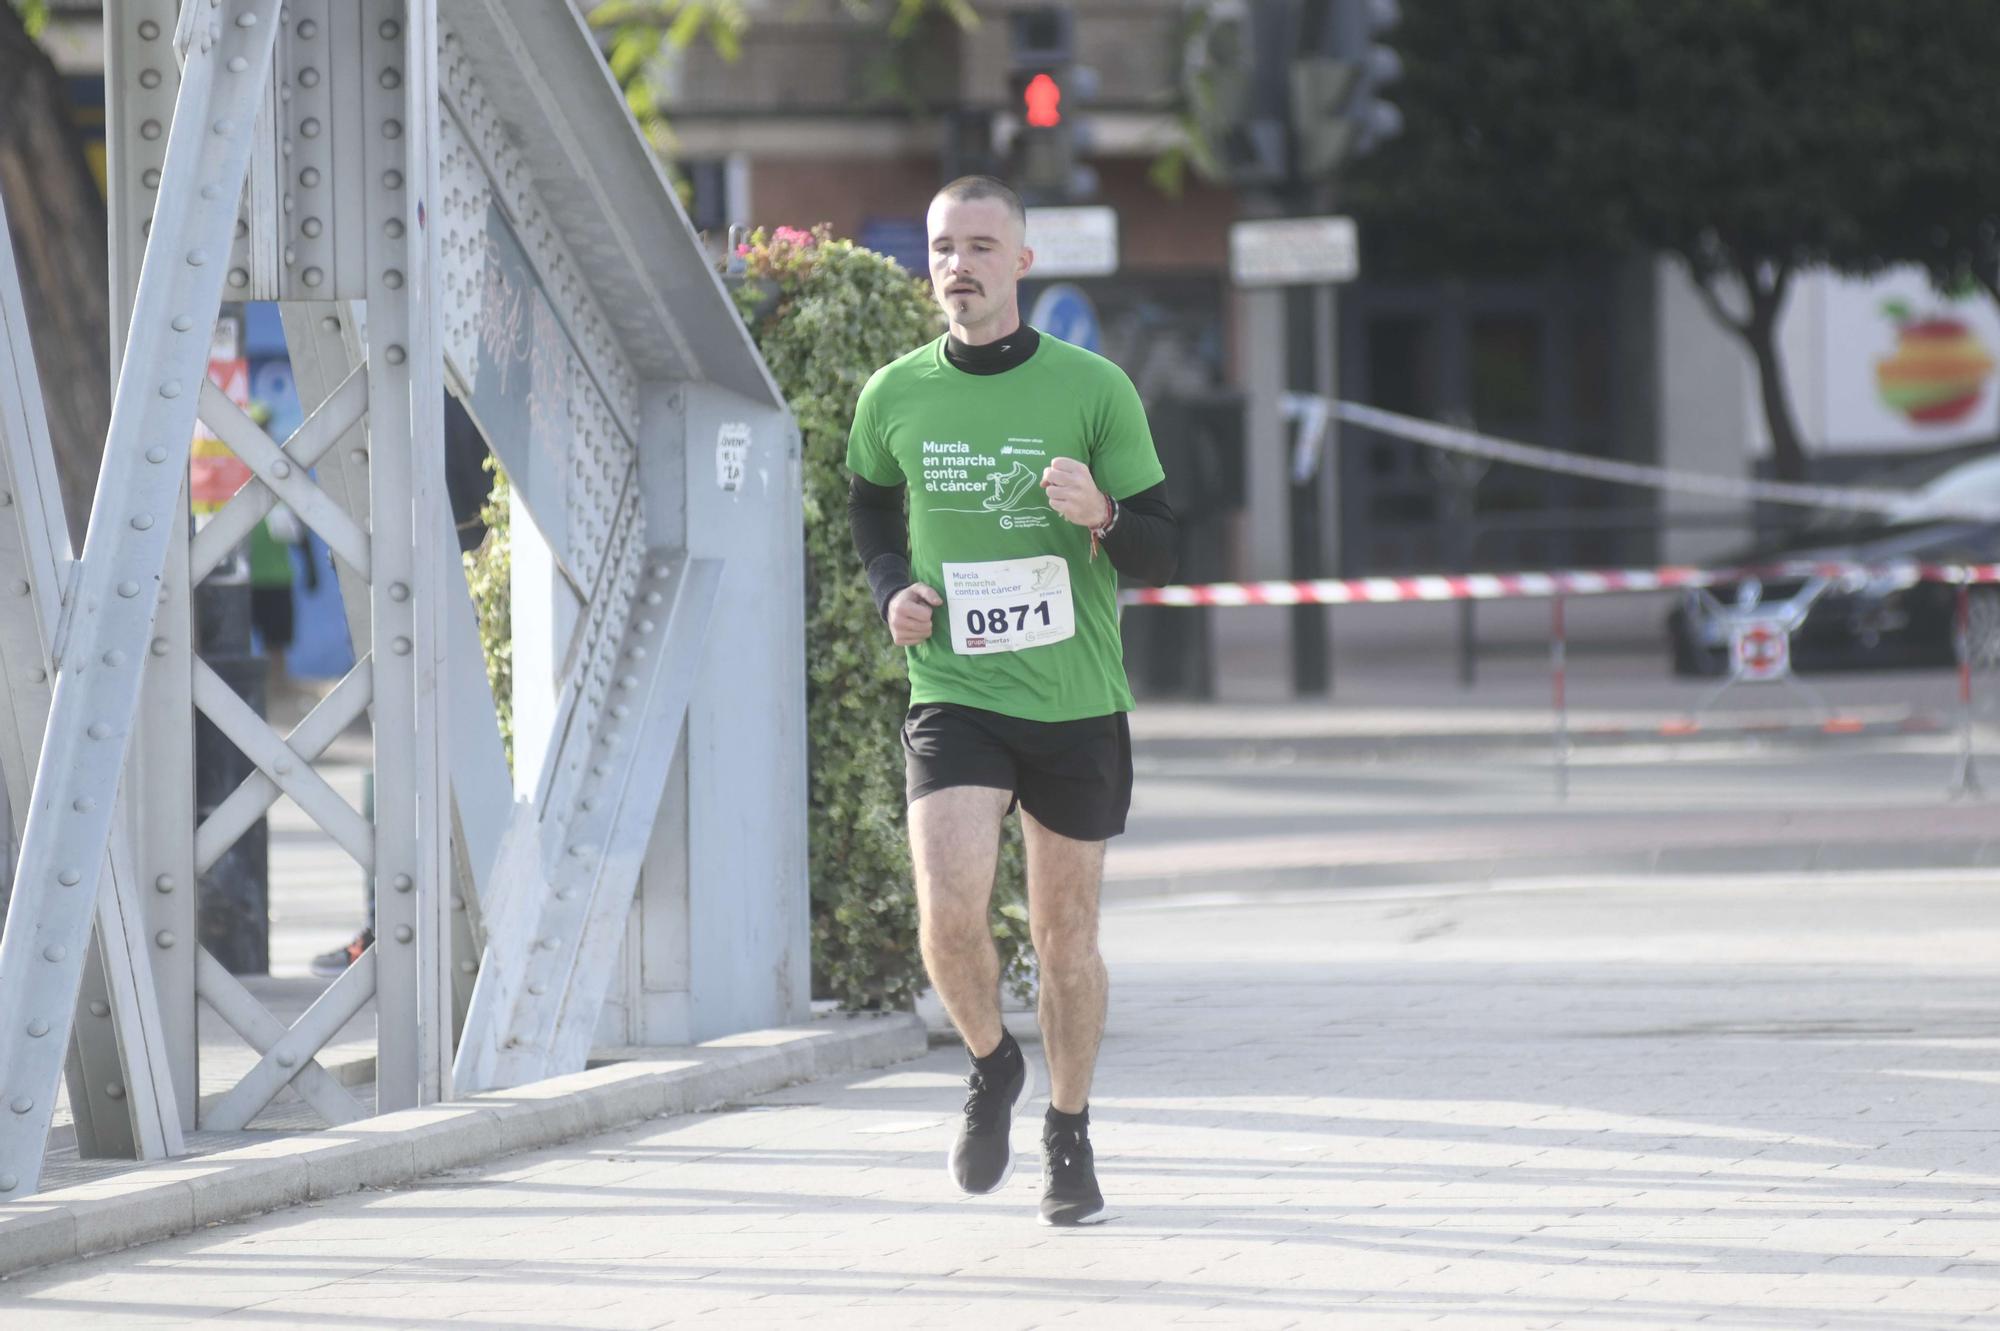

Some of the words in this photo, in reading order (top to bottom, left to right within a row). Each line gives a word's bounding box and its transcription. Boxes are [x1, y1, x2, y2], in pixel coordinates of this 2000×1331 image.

[922, 441, 969, 453] Murcia
[922, 457, 939, 466] en
[943, 454, 996, 466] marcha
[924, 468, 968, 480] contra
[925, 482, 938, 492] el
[940, 480, 988, 492] cáncer
[965, 579, 996, 587] marcha
[955, 588, 980, 596] contra
[982, 587, 989, 595] el
[992, 584, 1021, 595] cáncer
[966, 600, 1051, 635] 0871
